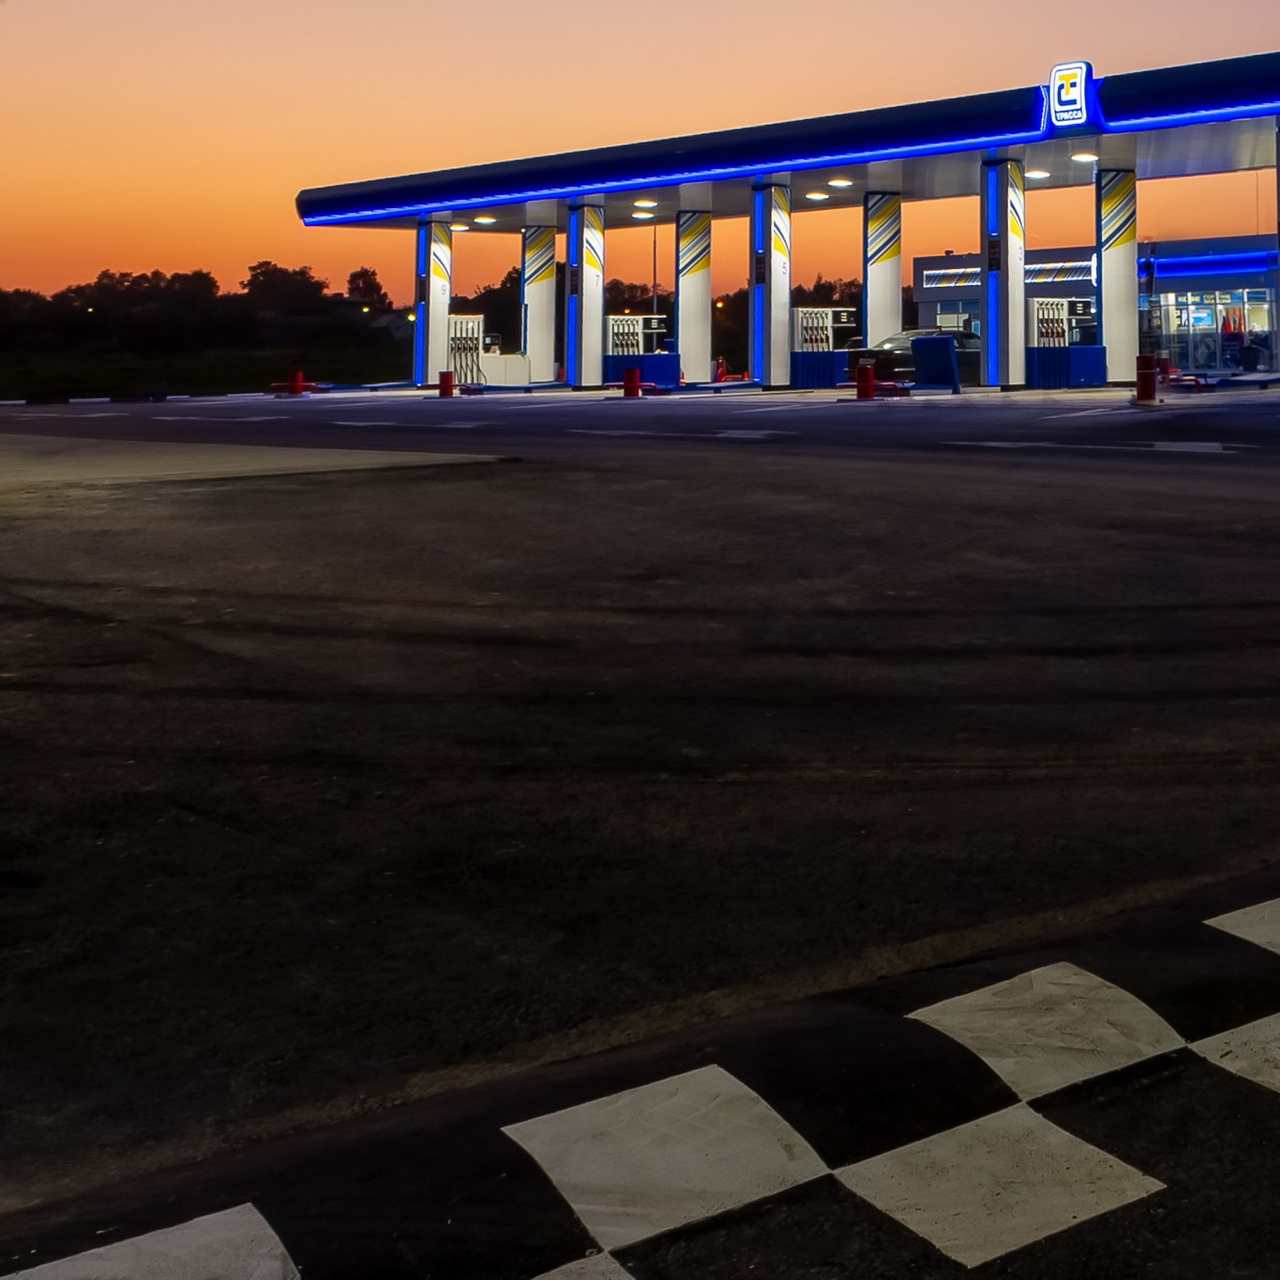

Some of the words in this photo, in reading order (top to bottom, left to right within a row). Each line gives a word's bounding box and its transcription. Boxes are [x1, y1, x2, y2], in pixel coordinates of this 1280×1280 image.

[1056, 110, 1082, 121] ТРАССА
[782, 262, 788, 275] 5
[595, 275, 601, 287] 7
[441, 284, 447, 295] 9
